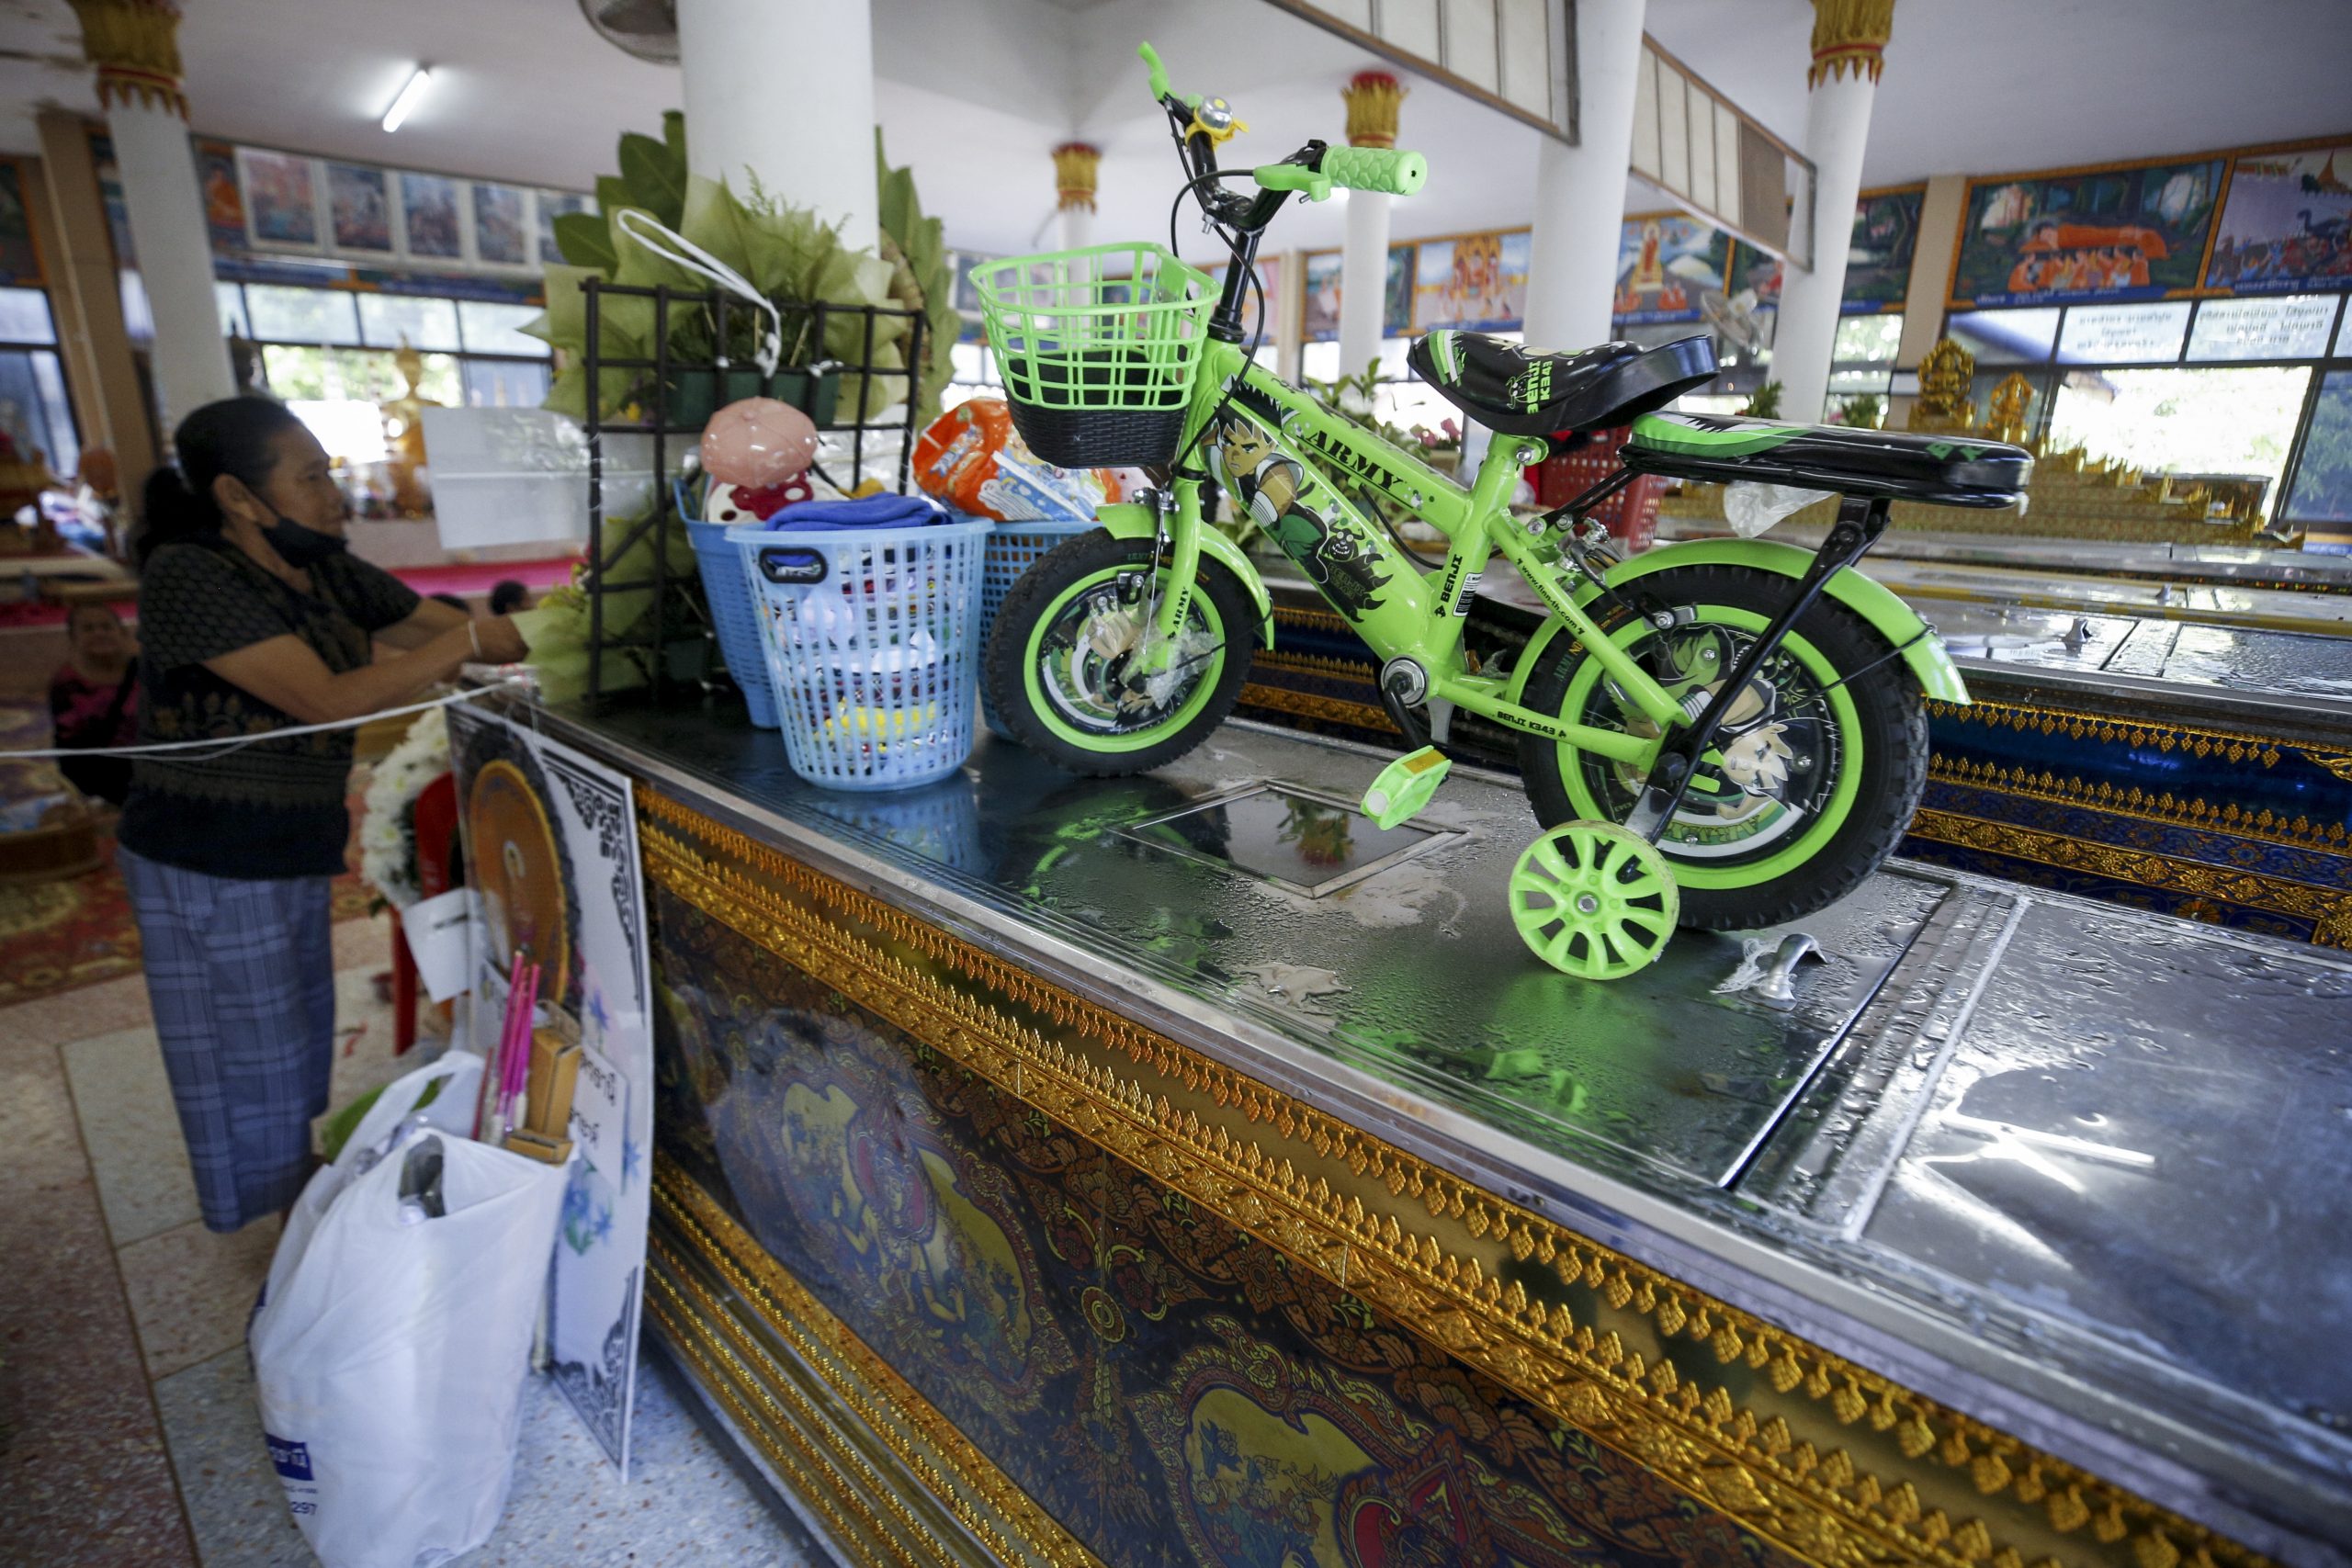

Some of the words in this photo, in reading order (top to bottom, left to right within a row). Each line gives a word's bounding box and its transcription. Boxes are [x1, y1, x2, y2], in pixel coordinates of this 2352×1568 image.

[1540, 360, 1553, 400] K343
[1306, 430, 1404, 491] ARMY
[1440, 553, 1463, 603] BENJI
[1521, 565, 1579, 632] www.finn-th.com
[1172, 586, 1190, 629] ARMY
[1497, 711, 1526, 727] BENJI
[1529, 720, 1555, 735] K343
